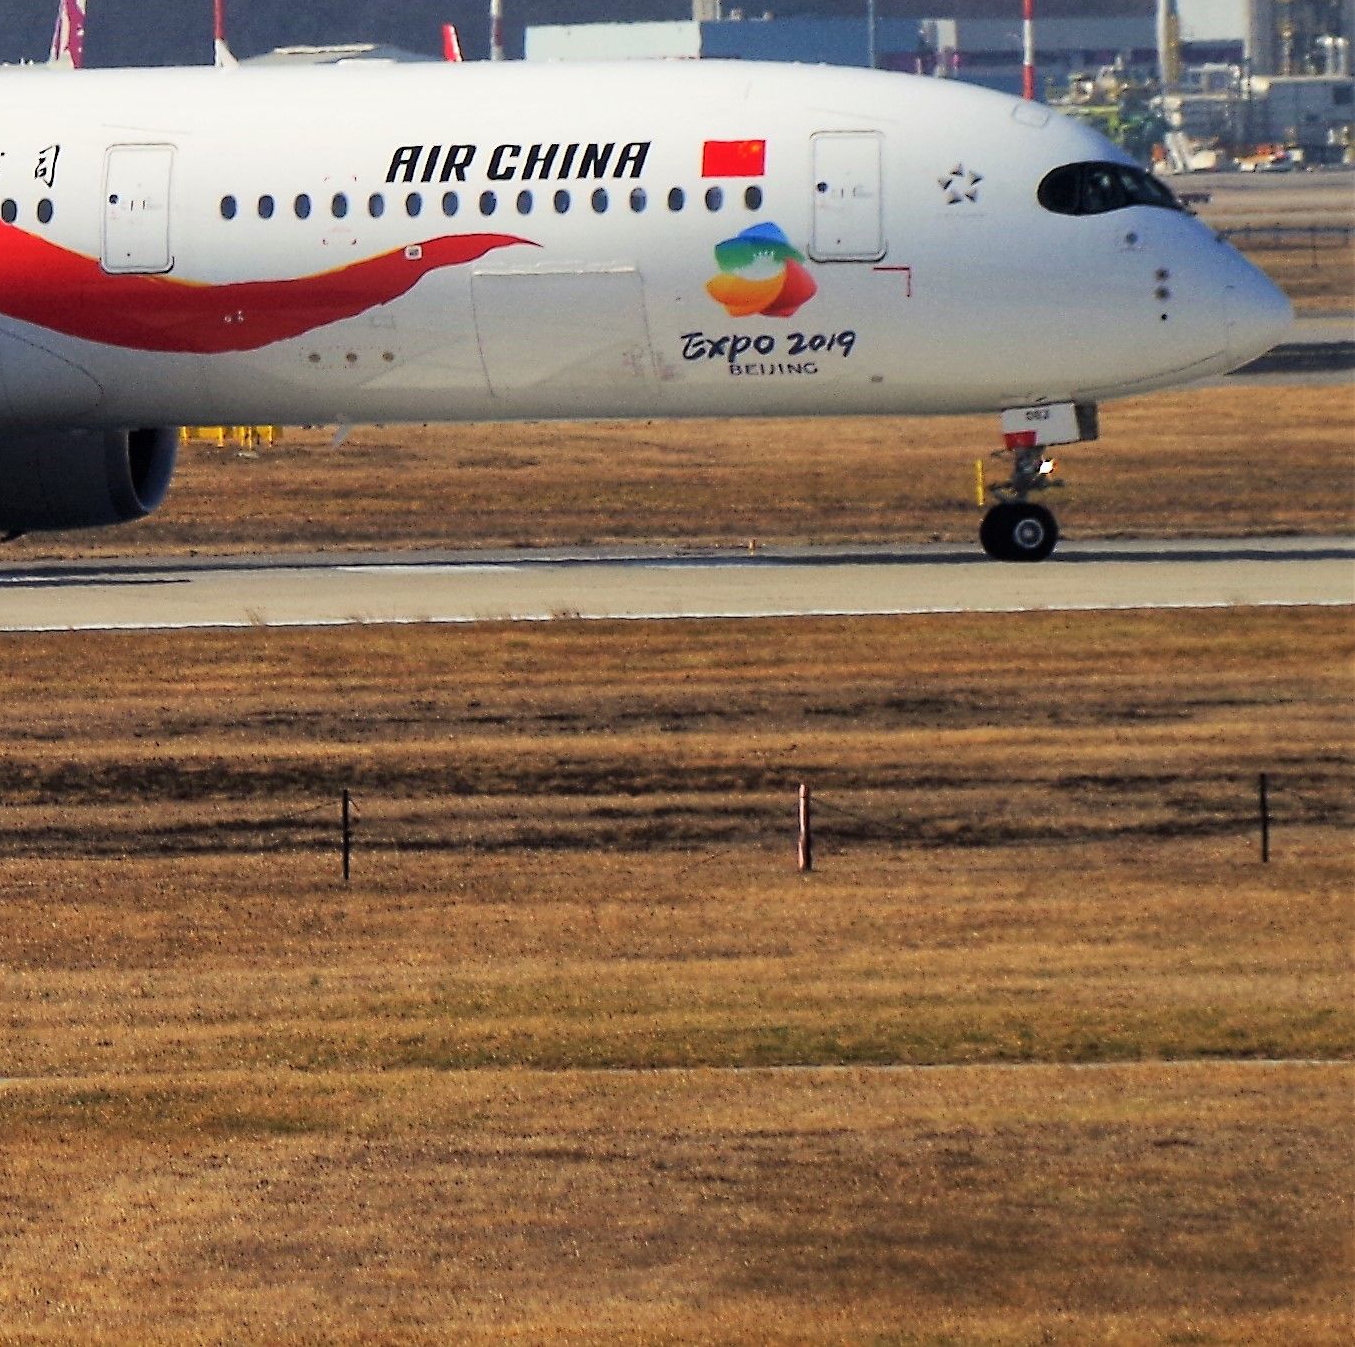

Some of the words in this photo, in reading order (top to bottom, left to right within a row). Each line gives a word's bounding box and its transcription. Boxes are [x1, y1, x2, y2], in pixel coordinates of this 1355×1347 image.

[385, 145, 478, 183] AIR
[486, 140, 653, 181] CHINA
[680, 331, 775, 363] Expo
[787, 329, 857, 357] 2019
[729, 362, 819, 377] BEIJING
